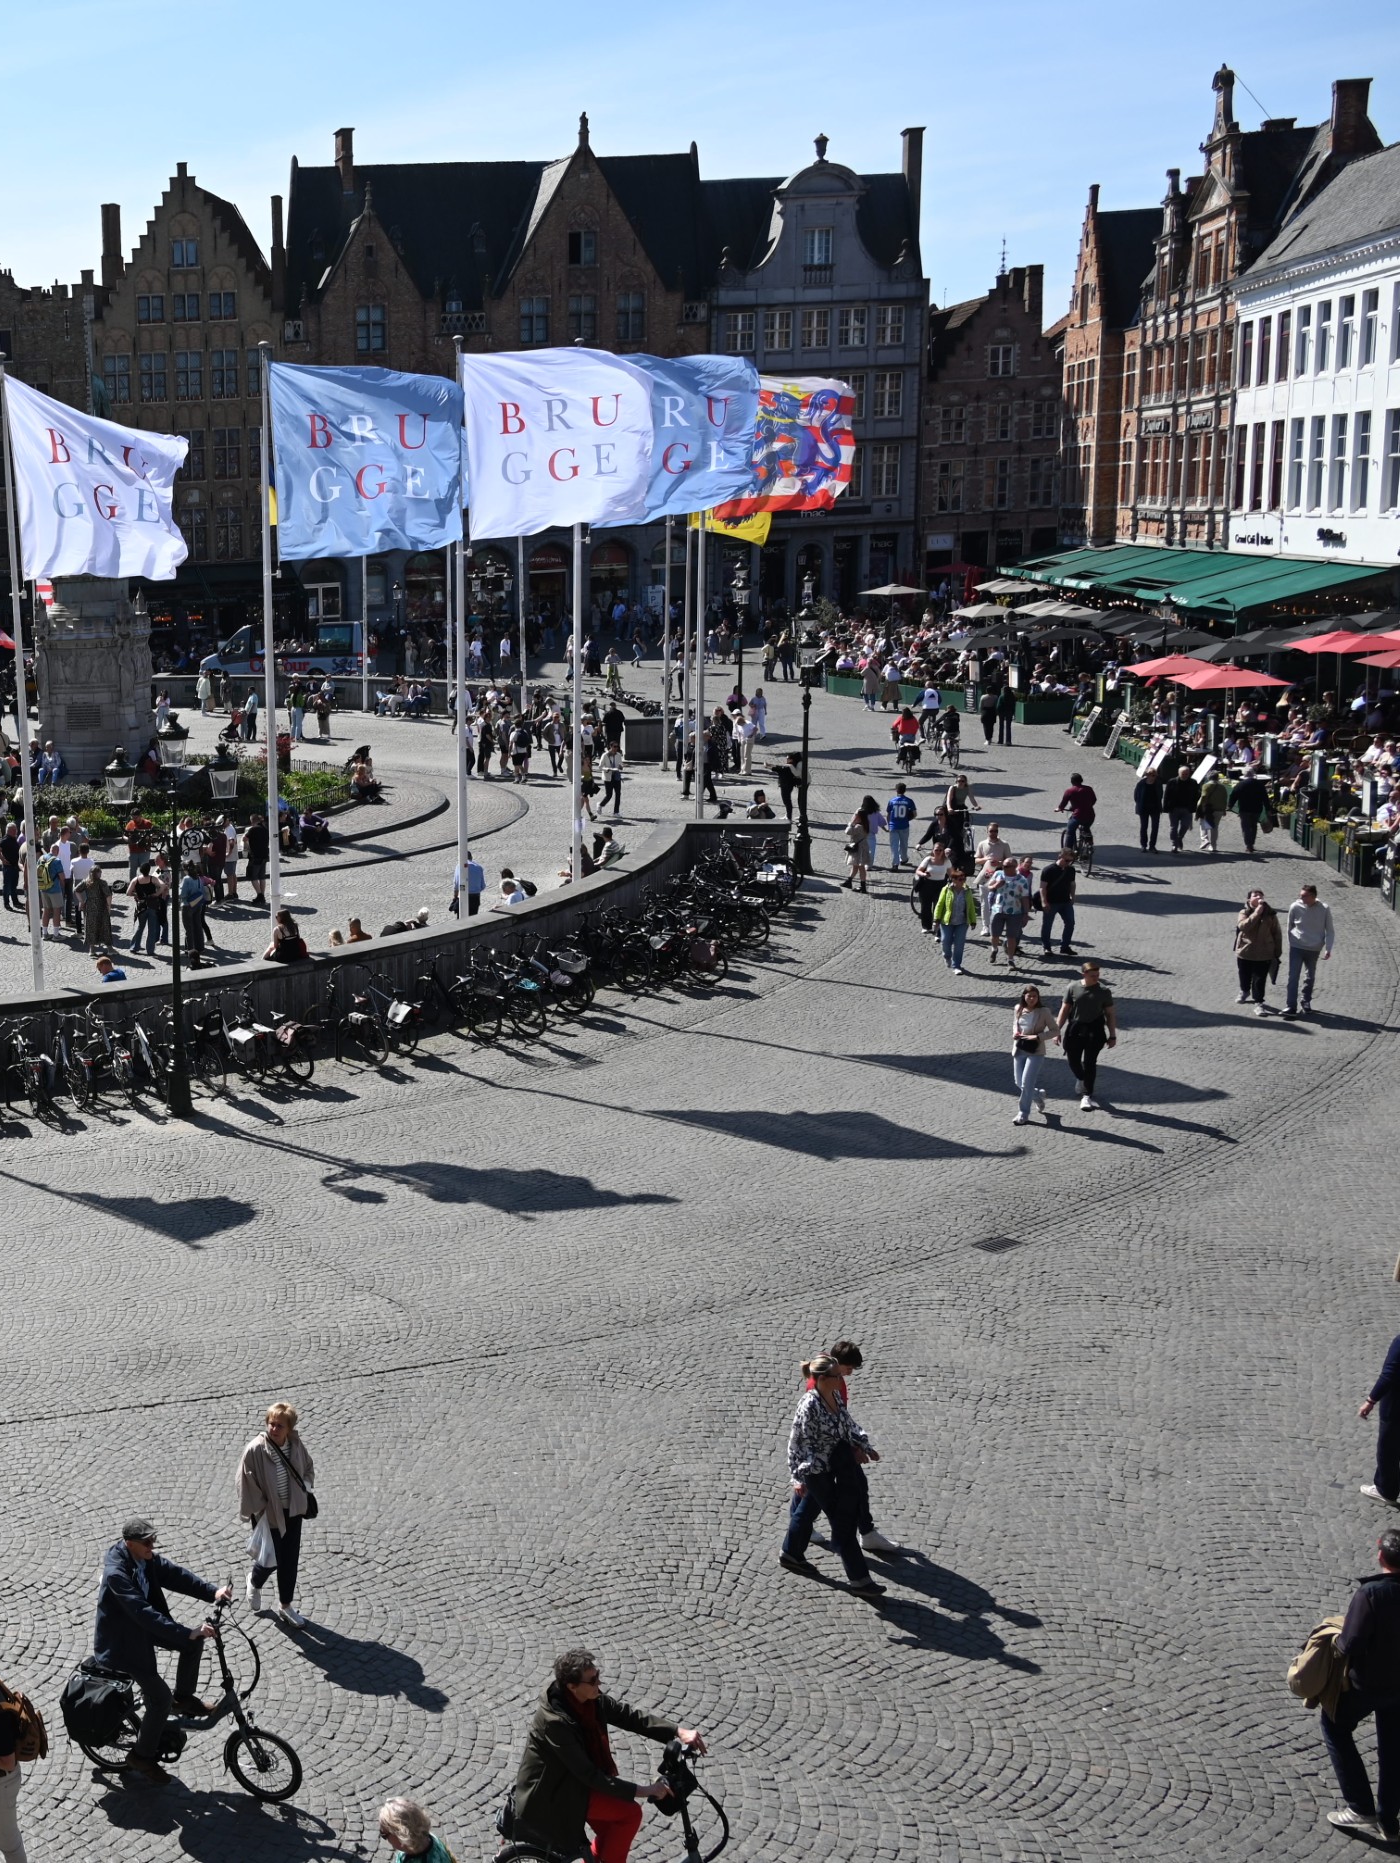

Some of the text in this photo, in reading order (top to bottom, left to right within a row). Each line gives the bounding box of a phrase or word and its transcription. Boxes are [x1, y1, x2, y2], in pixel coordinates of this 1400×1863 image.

[305, 413, 431, 449] BRU
[498, 393, 622, 434] BRU
[660, 396, 731, 428] RU
[45, 428, 149, 480] BRU
[501, 442, 618, 485] GGE
[661, 440, 731, 475] GE
[52, 482, 161, 524] GGE
[309, 463, 430, 503] GGE
[892, 805, 907, 818] 10
